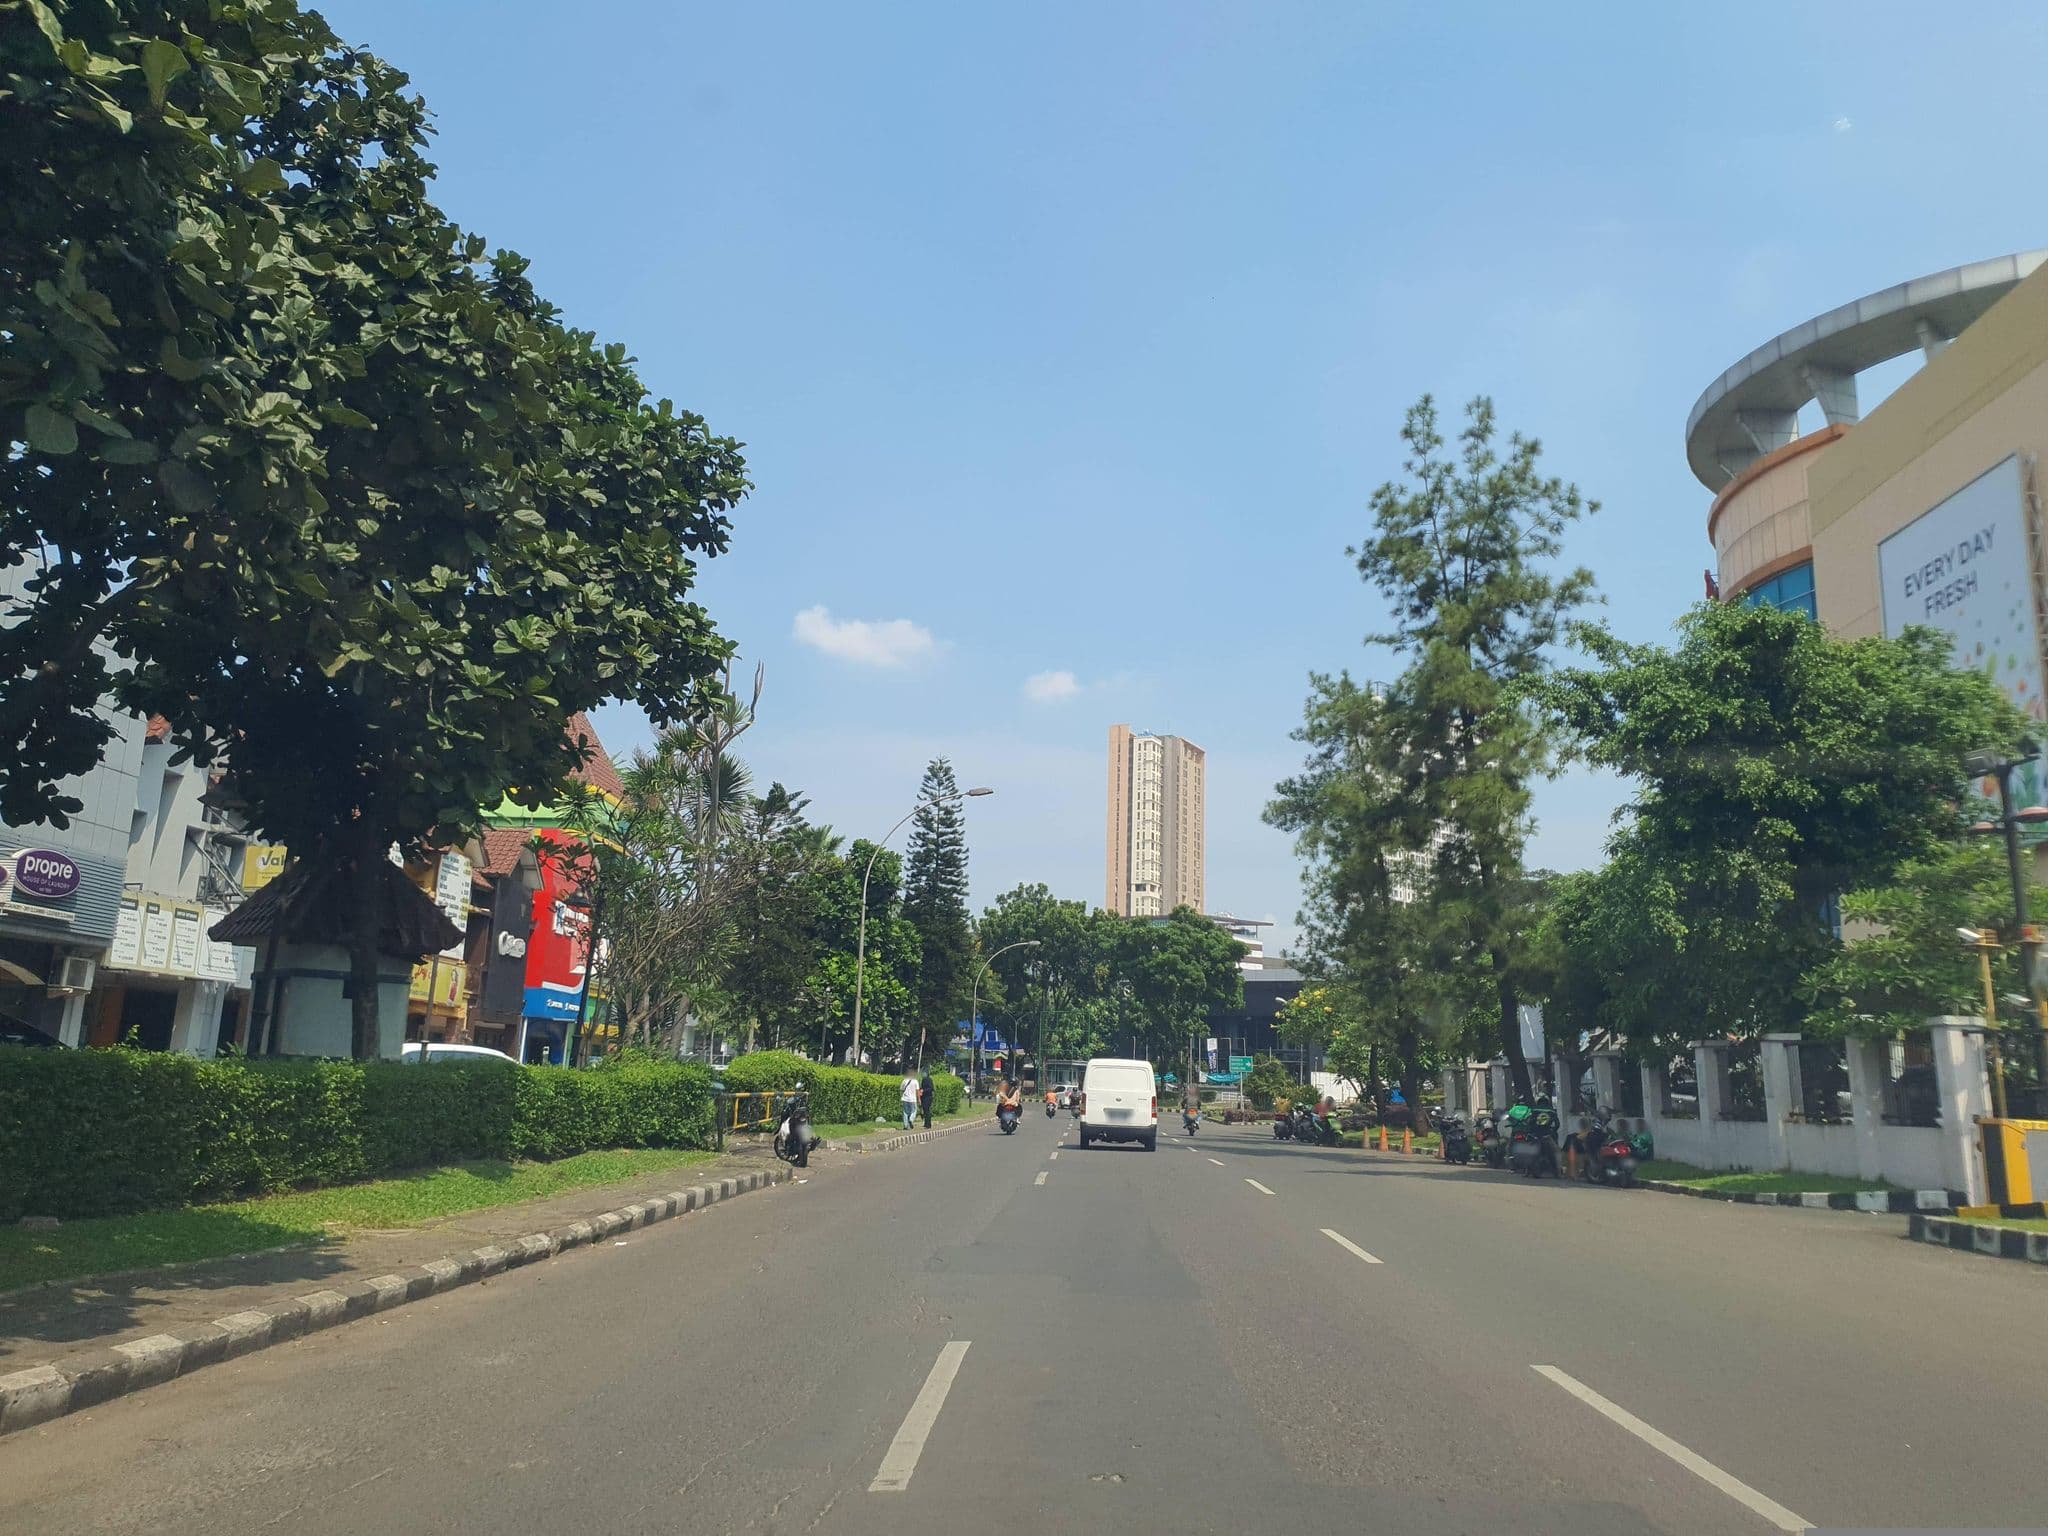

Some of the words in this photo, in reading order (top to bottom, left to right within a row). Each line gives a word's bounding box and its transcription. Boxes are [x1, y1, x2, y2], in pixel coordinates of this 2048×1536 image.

[1904, 548, 1955, 598] EVERY
[1959, 523, 1996, 565] DAY
[1925, 571, 1978, 618] FRESH
[24, 856, 73, 879] propre
